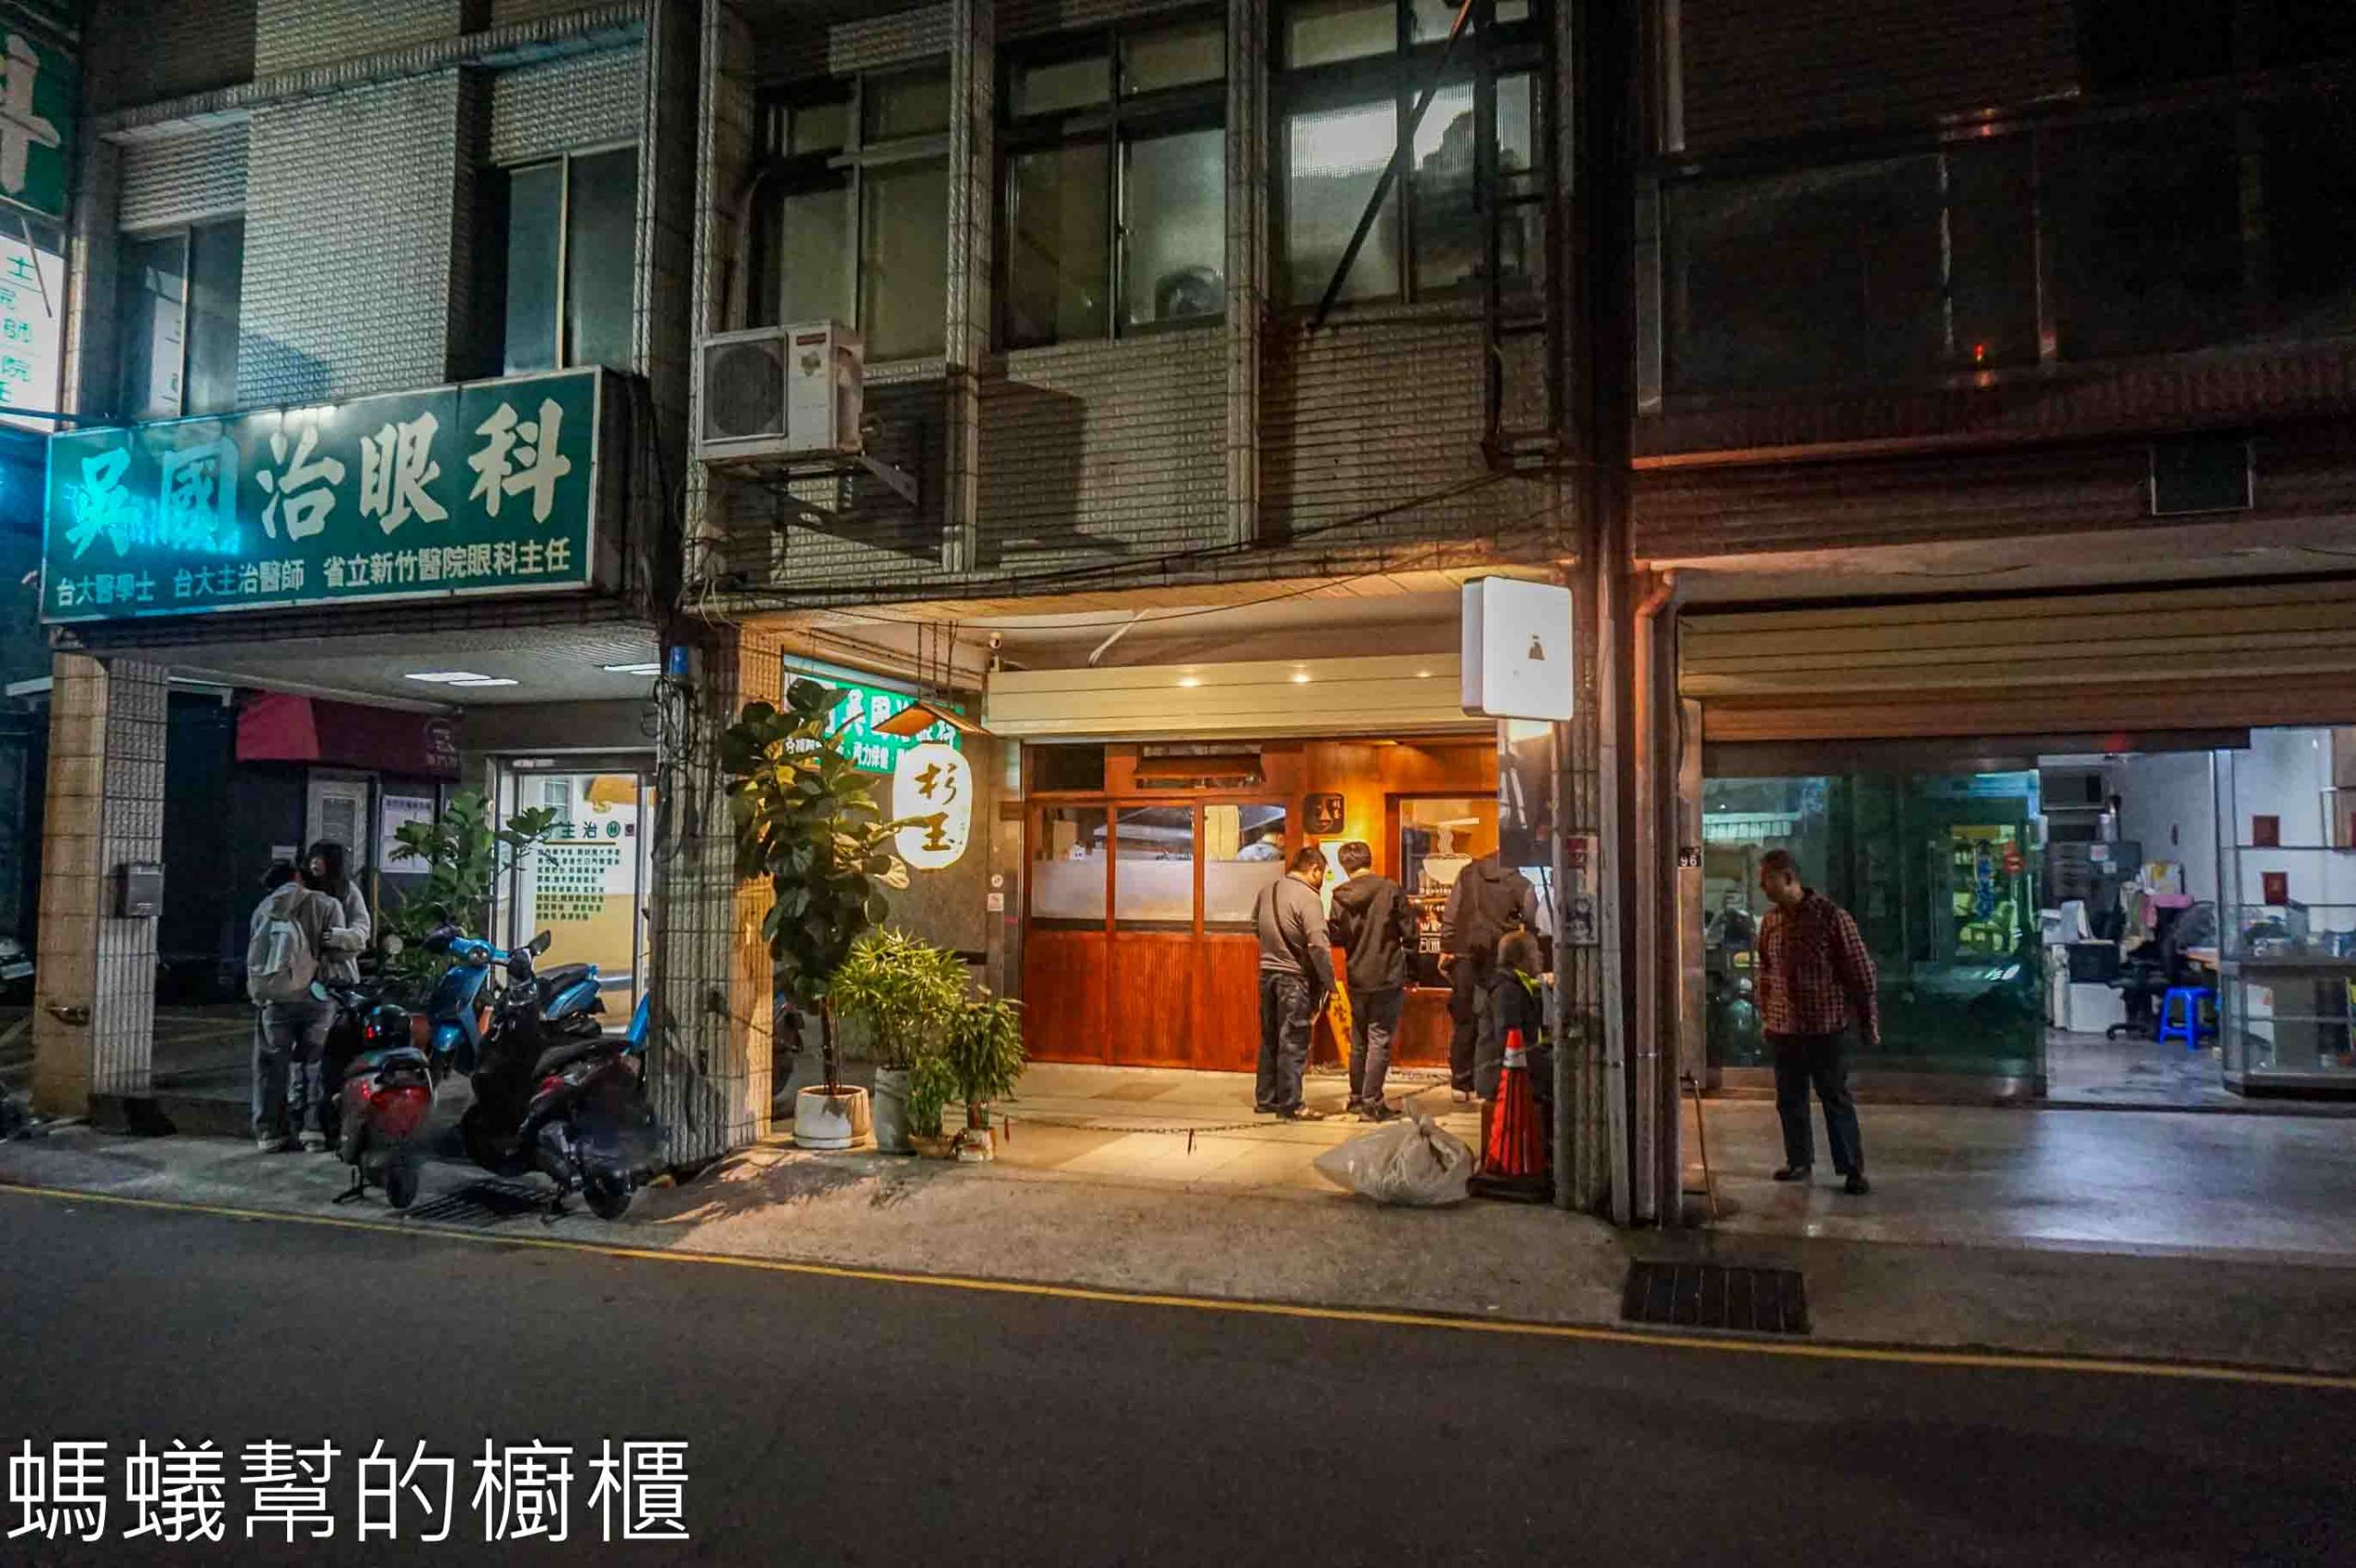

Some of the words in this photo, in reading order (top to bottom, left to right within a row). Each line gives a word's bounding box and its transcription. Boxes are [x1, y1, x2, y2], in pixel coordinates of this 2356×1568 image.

[65, 398, 572, 559] 吳國治眼科
[56, 571, 156, 606] 台大醫學士
[173, 559, 305, 598] 台大主治醫師
[323, 536, 571, 589] 省立新竹醫院眼科主任
